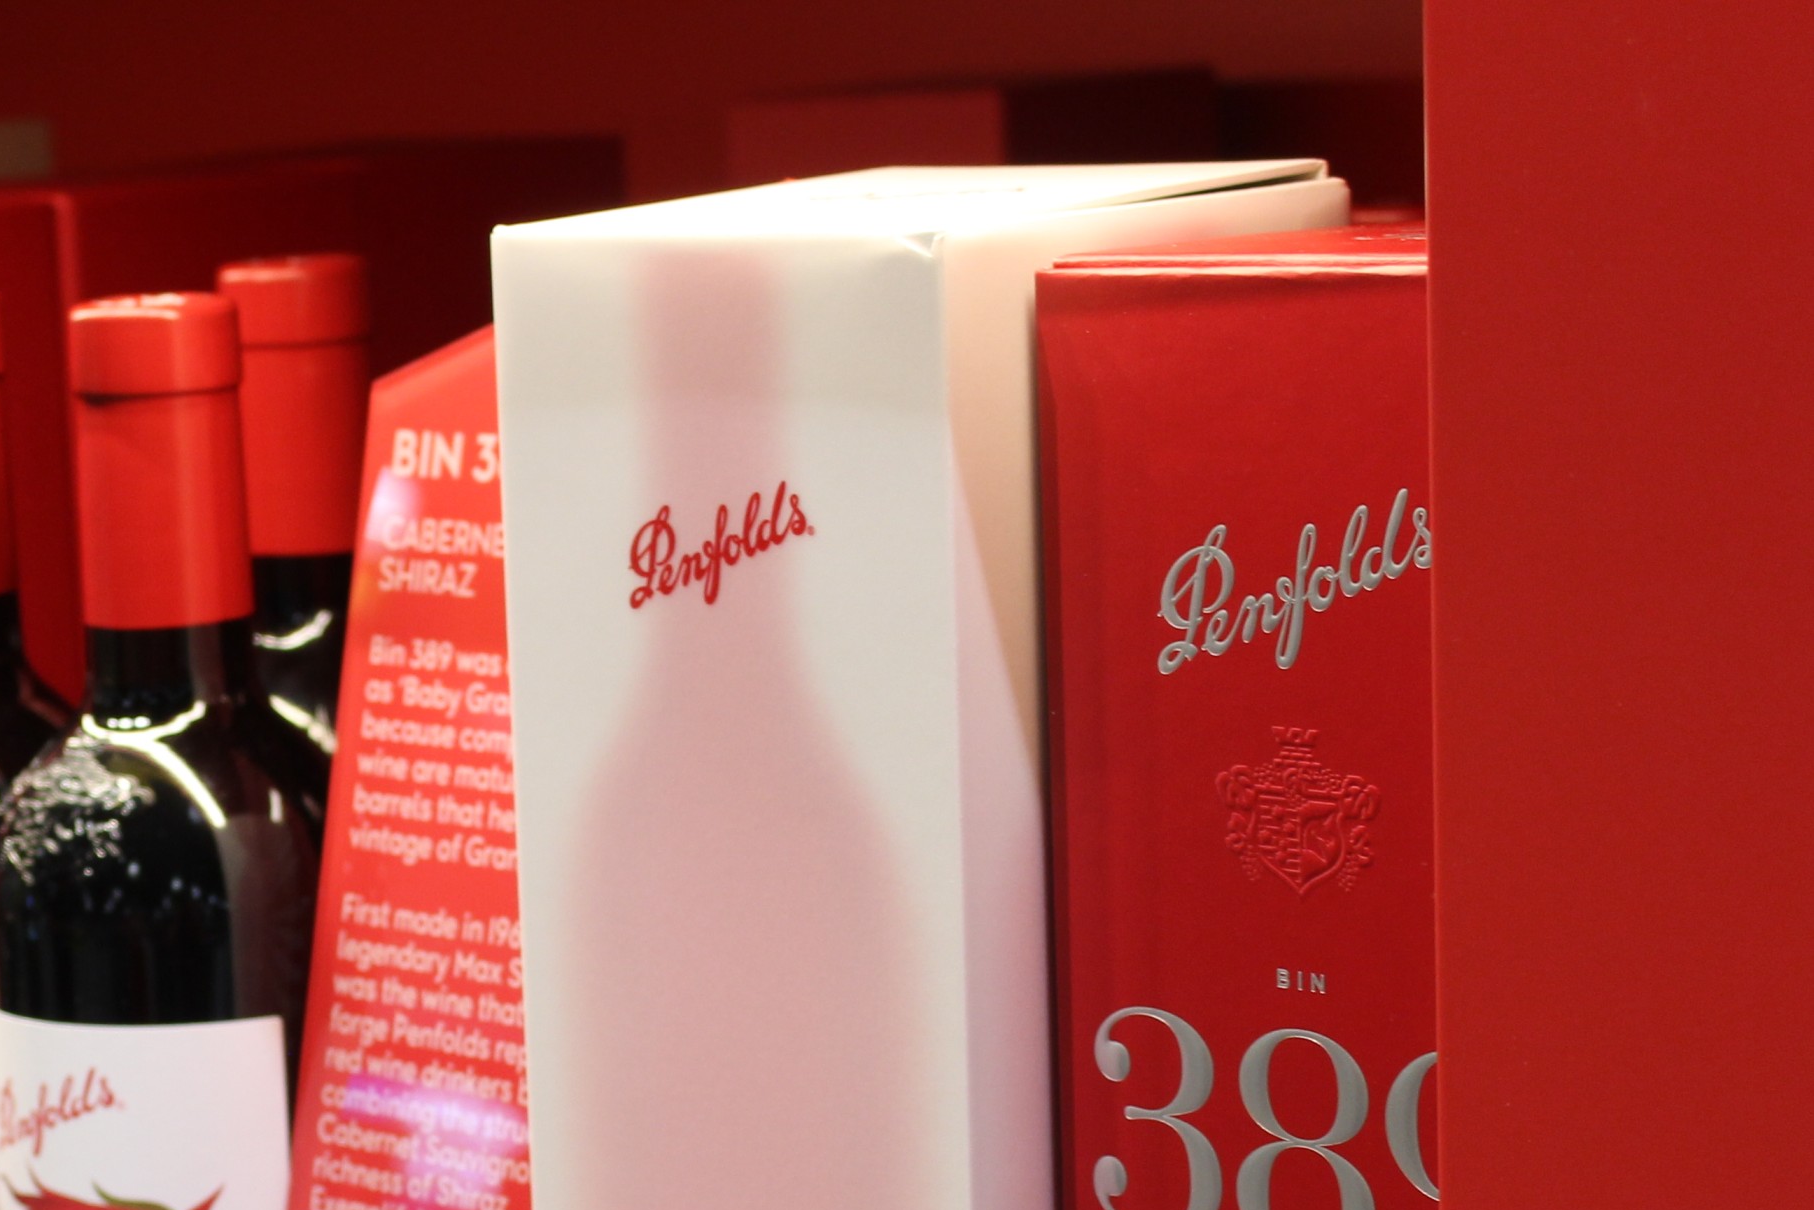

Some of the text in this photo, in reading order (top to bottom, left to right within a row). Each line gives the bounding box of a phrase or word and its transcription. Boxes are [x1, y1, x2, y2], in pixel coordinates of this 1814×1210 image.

[392, 427, 500, 484] BIN 3
[382, 514, 504, 559] CABERNE
[628, 480, 808, 610] Penfolds
[378, 554, 478, 598] SHIRAZ
[1156, 487, 1434, 676] Penfolds
[368, 633, 502, 678] Bin 389 was
[364, 678, 394, 704] as
[465, 681, 511, 716] Gra
[360, 708, 457, 749] because
[356, 747, 514, 795] wine are matu
[352, 782, 433, 823] barrels
[437, 794, 485, 830] that
[349, 820, 518, 872] vintage of Gran
[340, 891, 522, 950] First made in 196
[337, 929, 451, 984] legendary
[453, 949, 504, 985] Max
[1276, 967, 1327, 995] BIN
[333, 973, 377, 1003] was
[381, 975, 418, 1010] the
[420, 983, 474, 1020] wine
[329, 1001, 527, 1075] forge Penfolds rep
[324, 1045, 365, 1074] red
[366, 1050, 419, 1085] wine
[420, 1059, 514, 1105] drinkers
[440, 1099, 481, 1137] the
[482, 1110, 529, 1146] stru
[316, 1110, 530, 1188] Cabernet Sauvigno
[312, 1151, 404, 1197] richness
[406, 1171, 433, 1201] of
